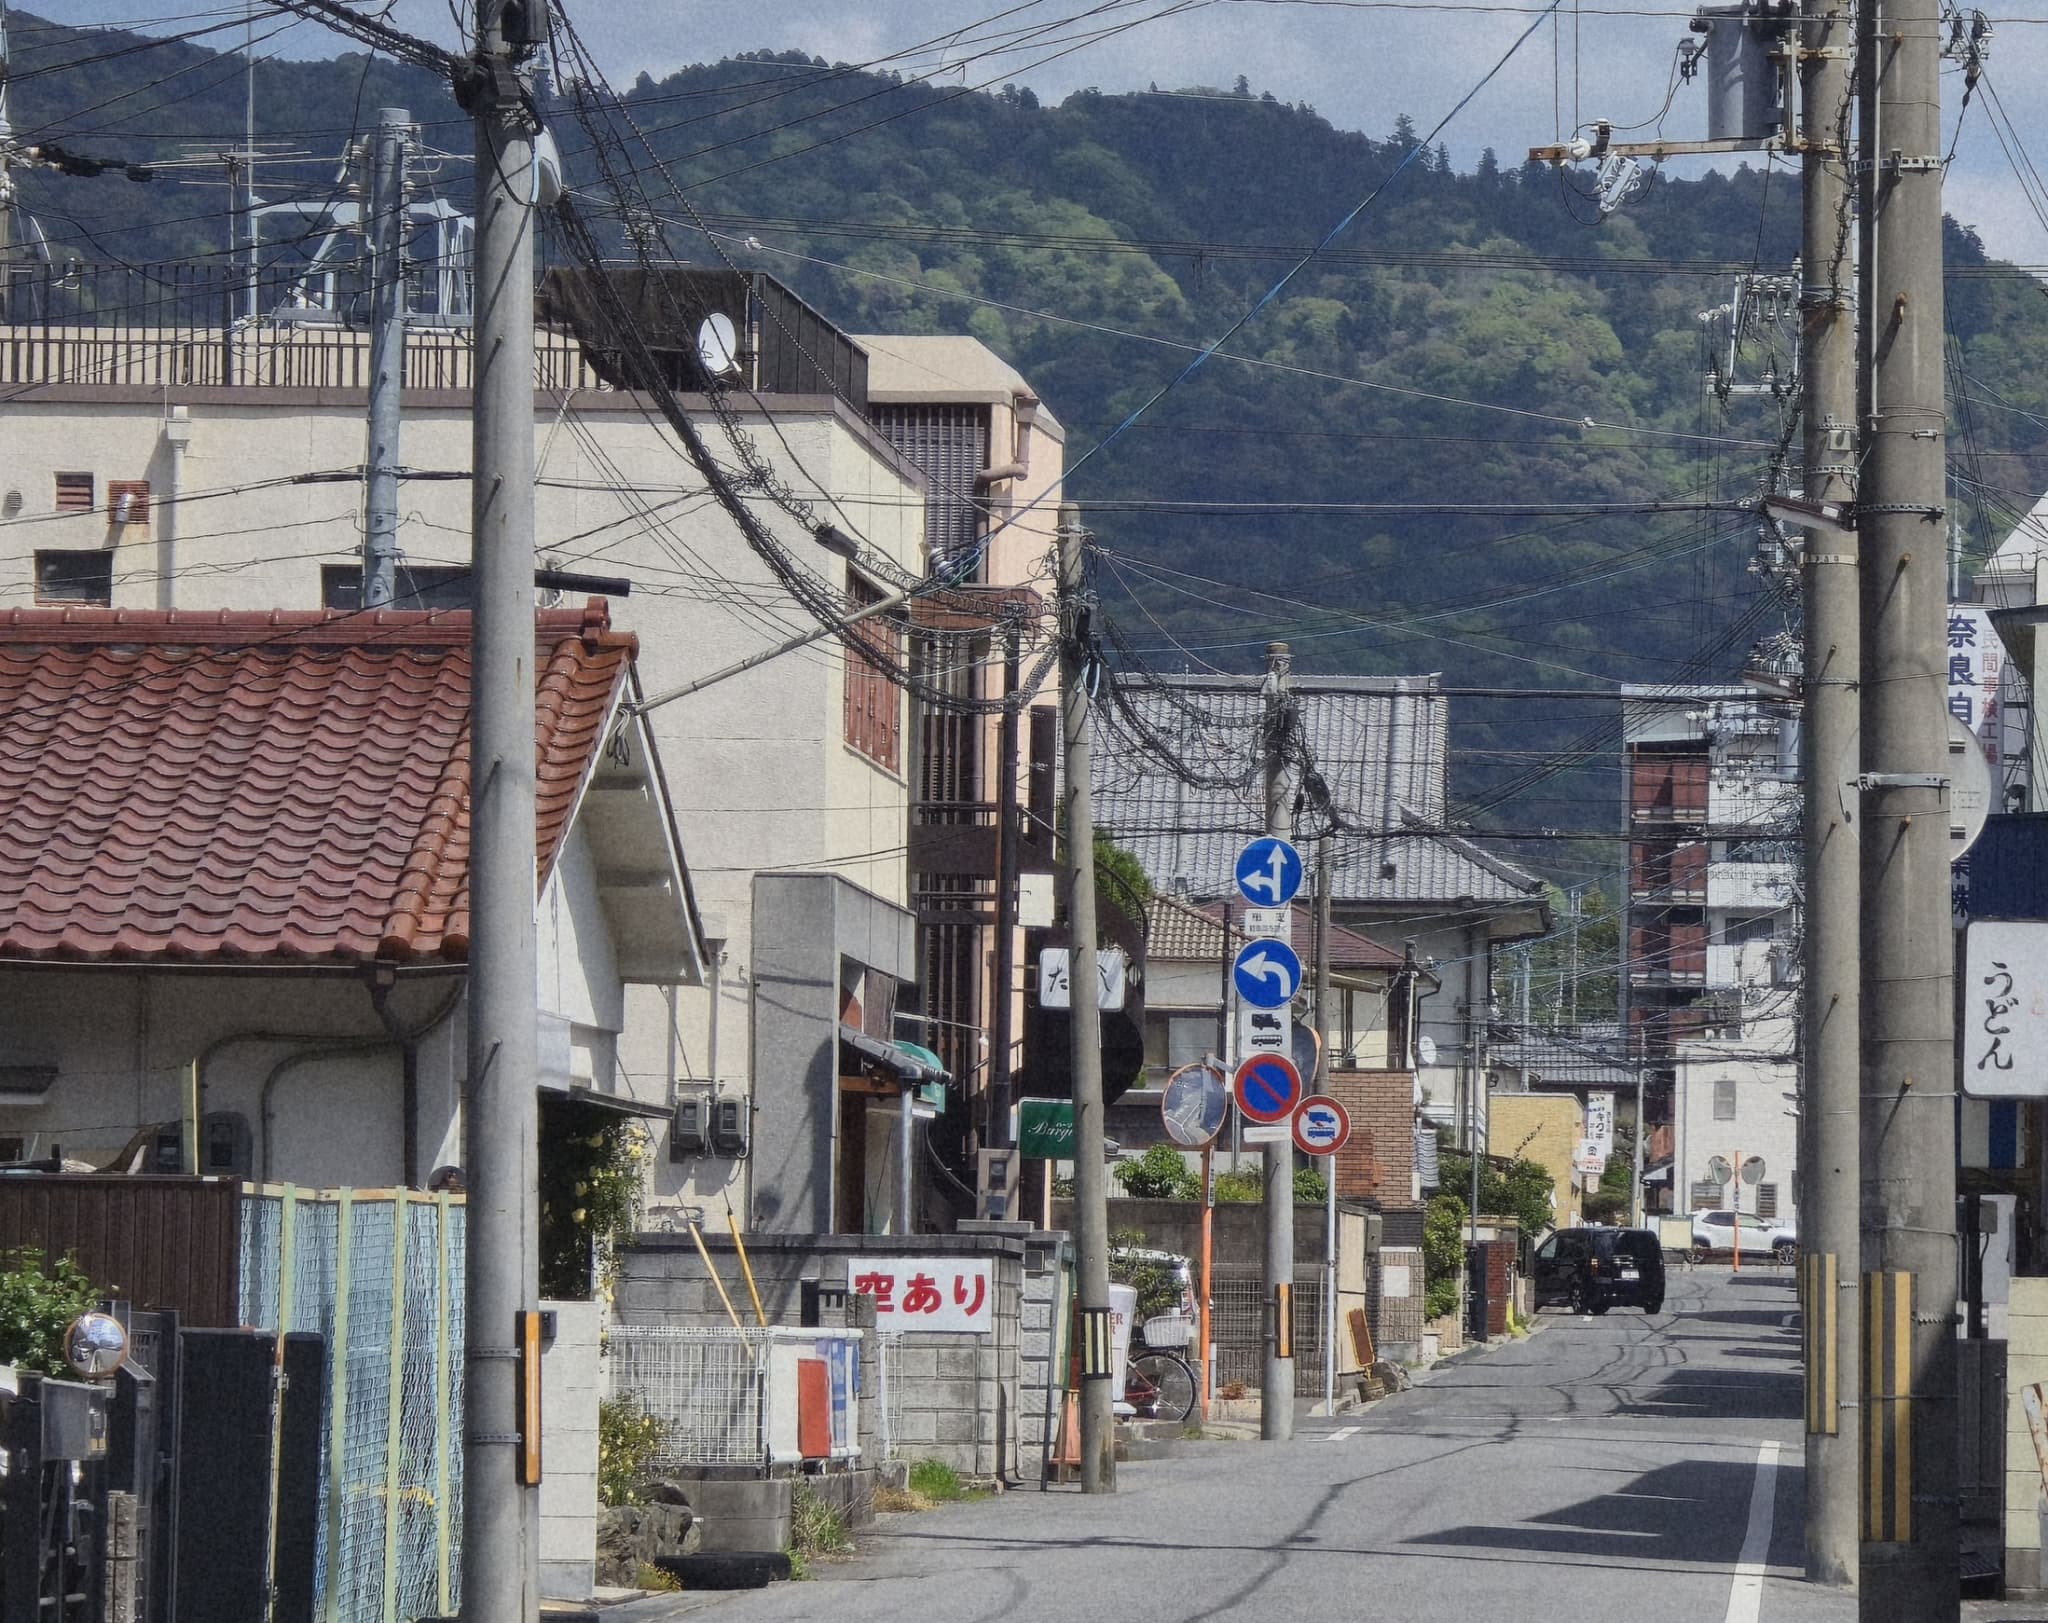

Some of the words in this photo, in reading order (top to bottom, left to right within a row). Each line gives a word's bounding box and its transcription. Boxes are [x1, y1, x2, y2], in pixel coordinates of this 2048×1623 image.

[1983, 629, 1998, 765] 民間車検工場
[1977, 961, 2020, 1071] うどん
[855, 1271, 986, 1317] 空あり
